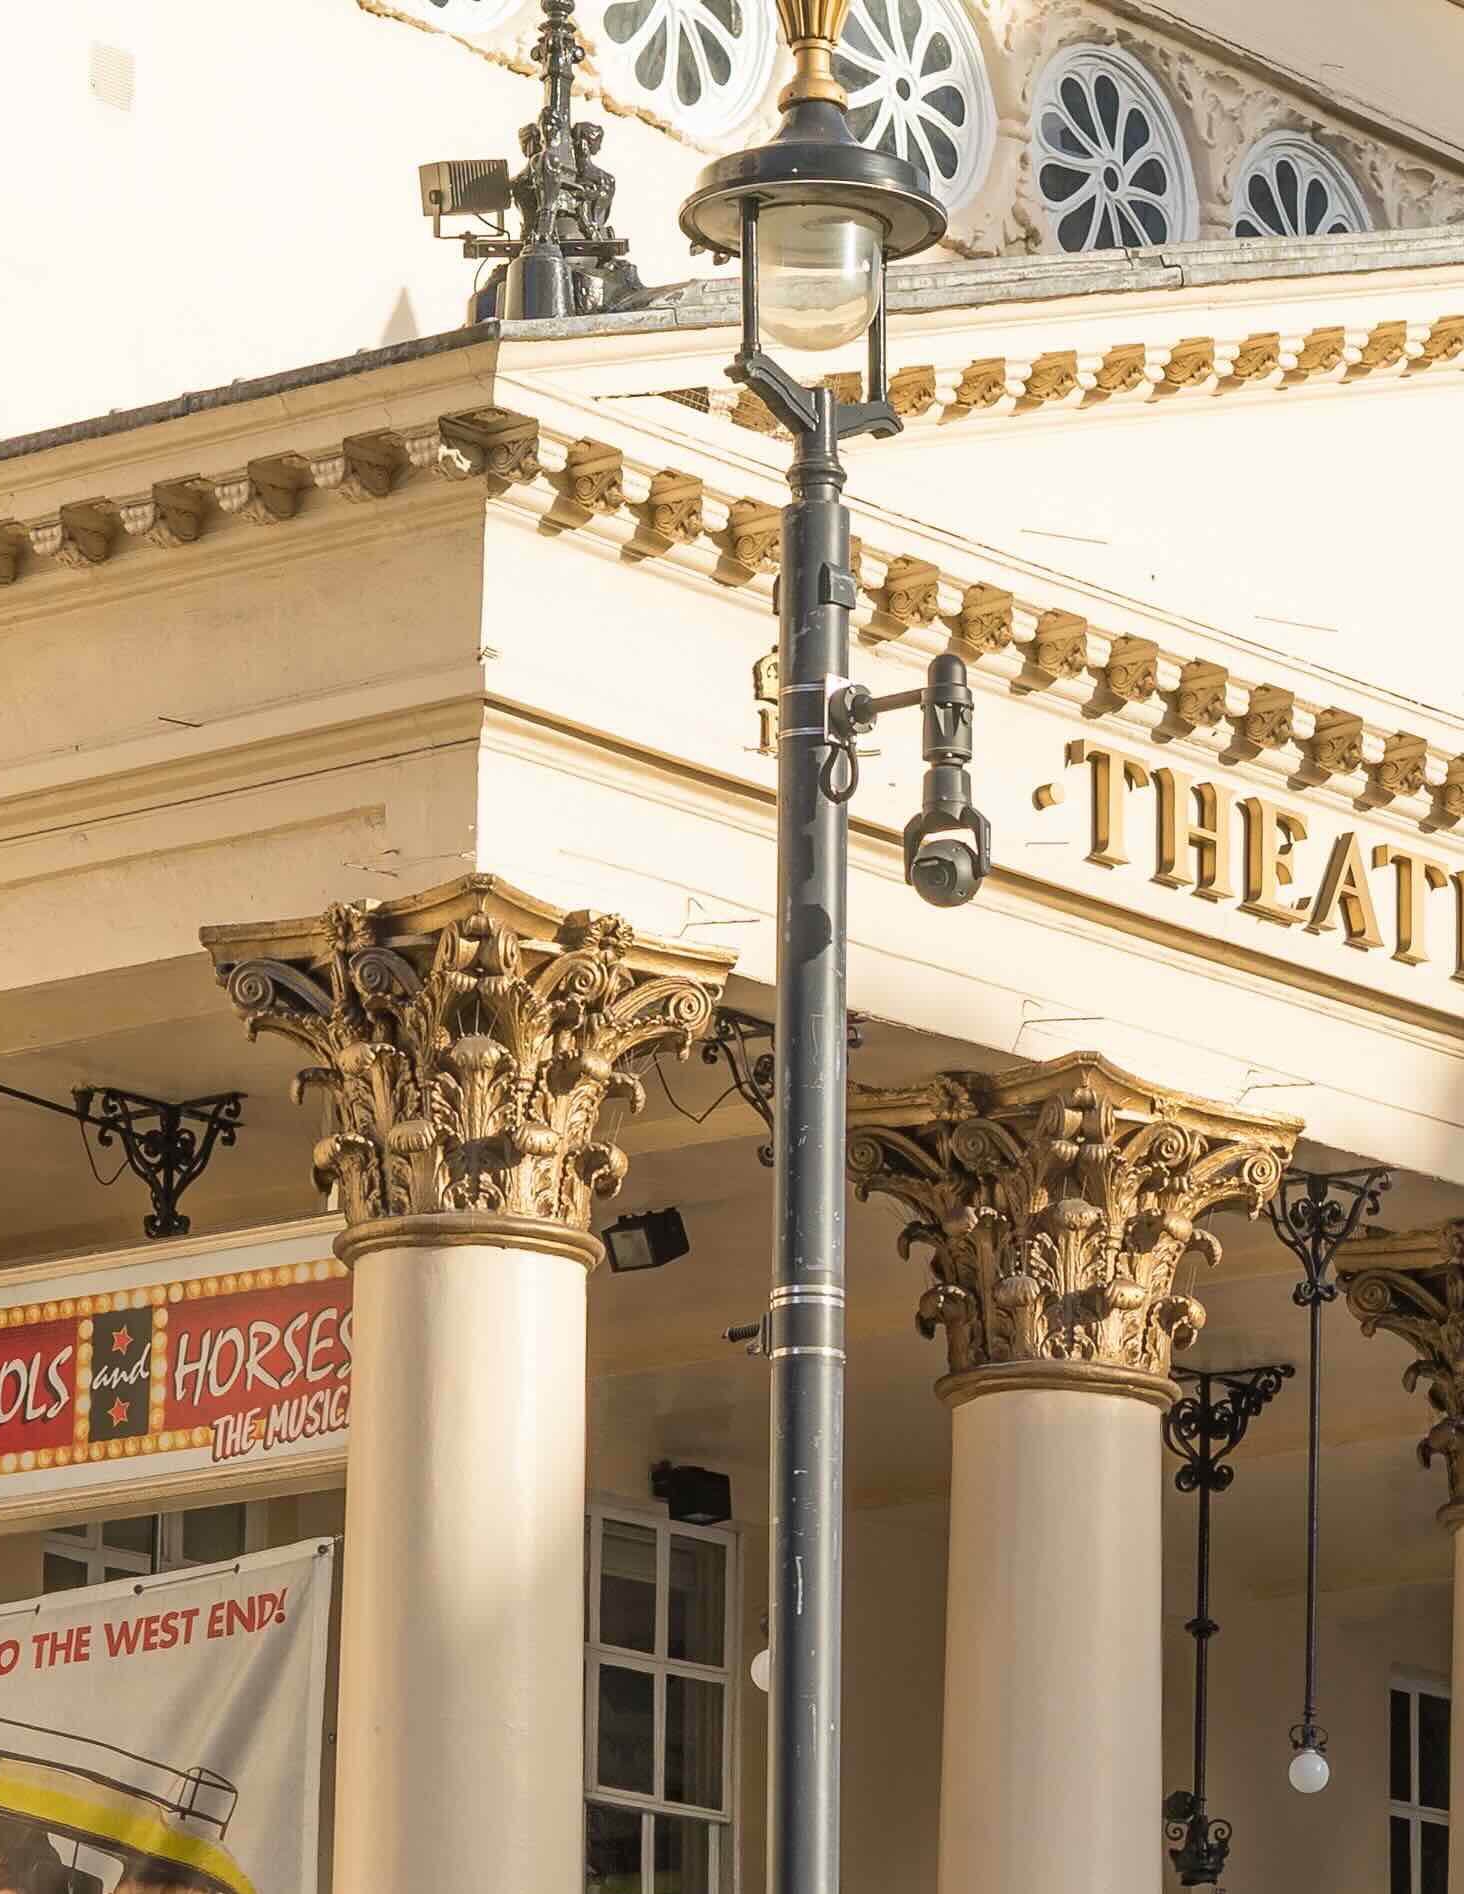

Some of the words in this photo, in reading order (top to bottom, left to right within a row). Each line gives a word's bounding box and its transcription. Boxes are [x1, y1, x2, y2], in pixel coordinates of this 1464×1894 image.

[91, 1342, 151, 1392] and
[210, 1411, 257, 1463] THE
[264, 1380, 353, 1448] MUSIC
[32, 1623, 93, 1669] THE
[102, 1606, 200, 1657] WEST
[205, 1587, 290, 1639] END!
